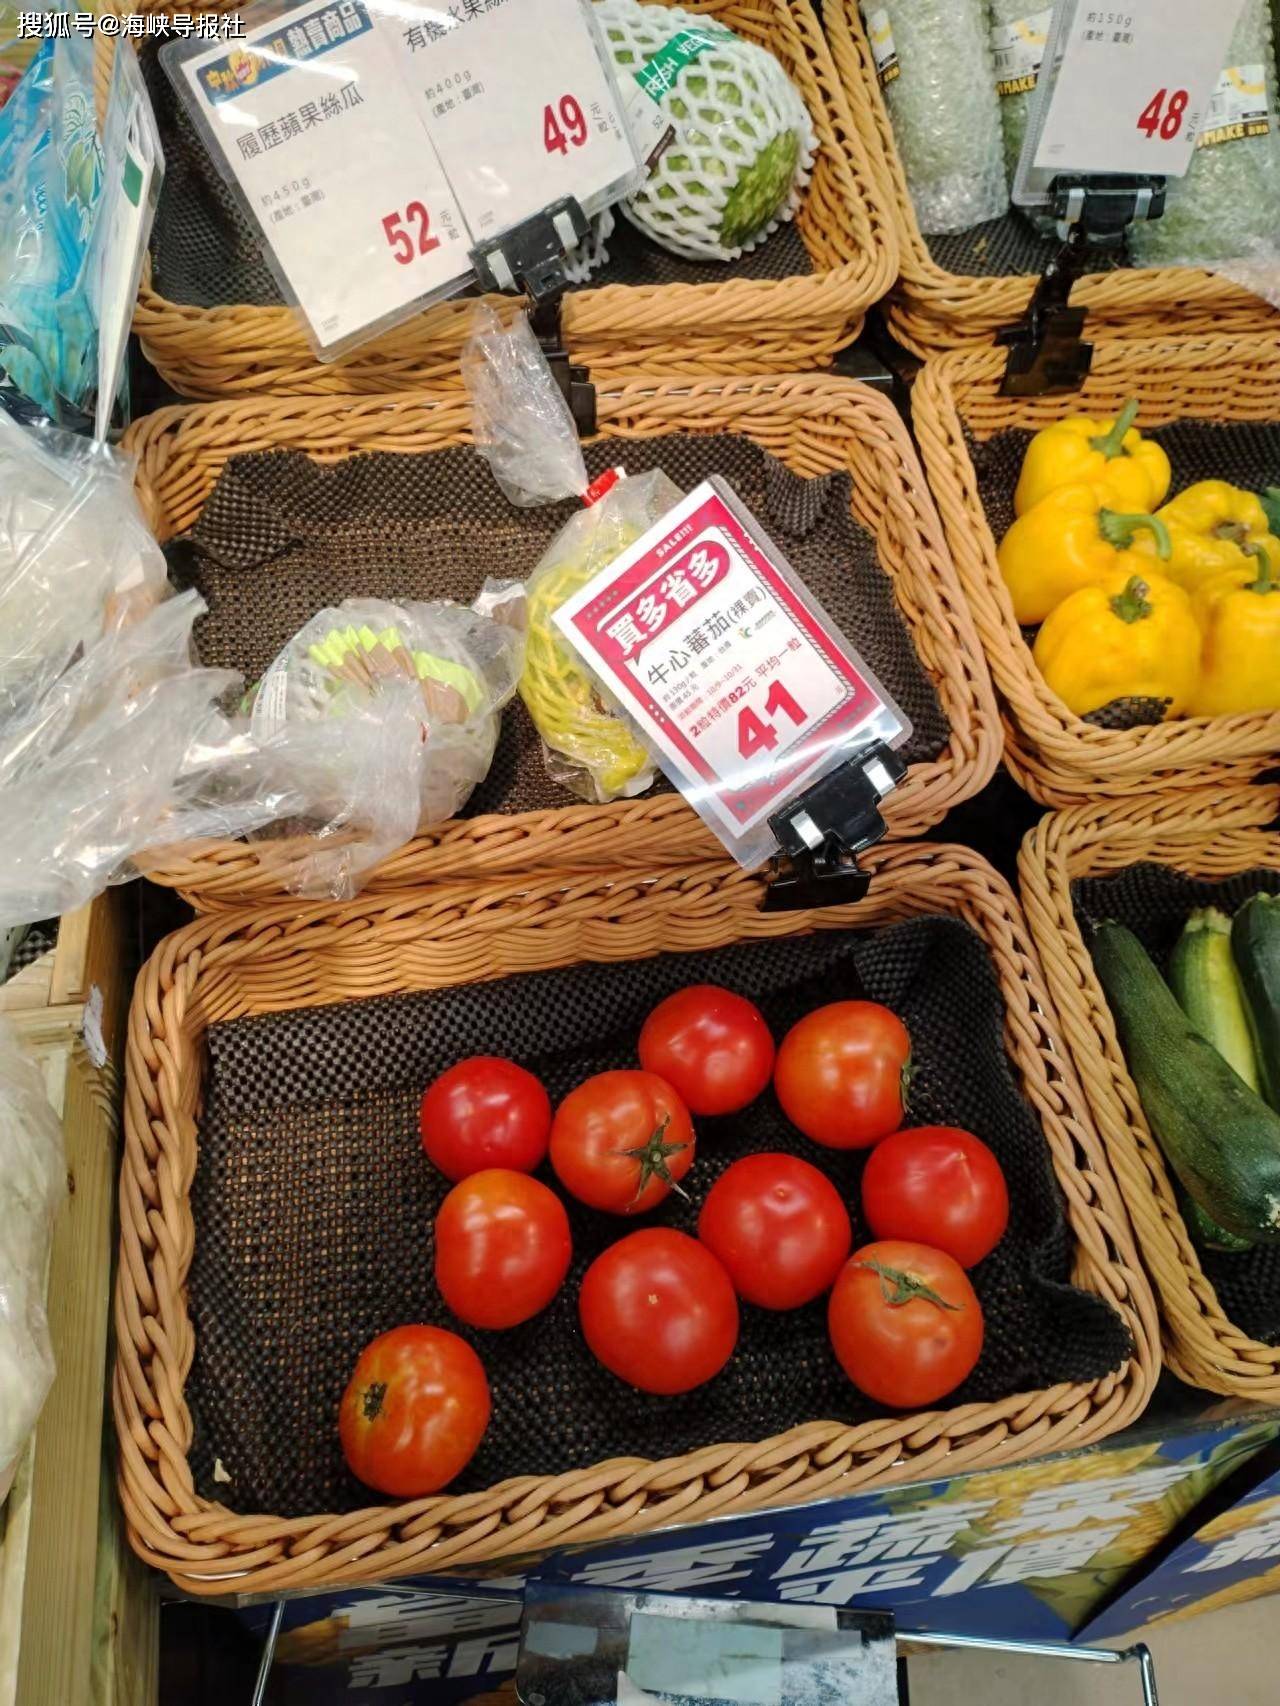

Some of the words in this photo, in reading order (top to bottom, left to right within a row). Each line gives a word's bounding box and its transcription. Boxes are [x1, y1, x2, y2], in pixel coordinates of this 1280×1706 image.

[544, 94, 588, 155] 49
[1137, 88, 1189, 140] 48
[382, 200, 441, 265] 52
[605, 549, 720, 656] 買多省多
[738, 679, 808, 760] 41
